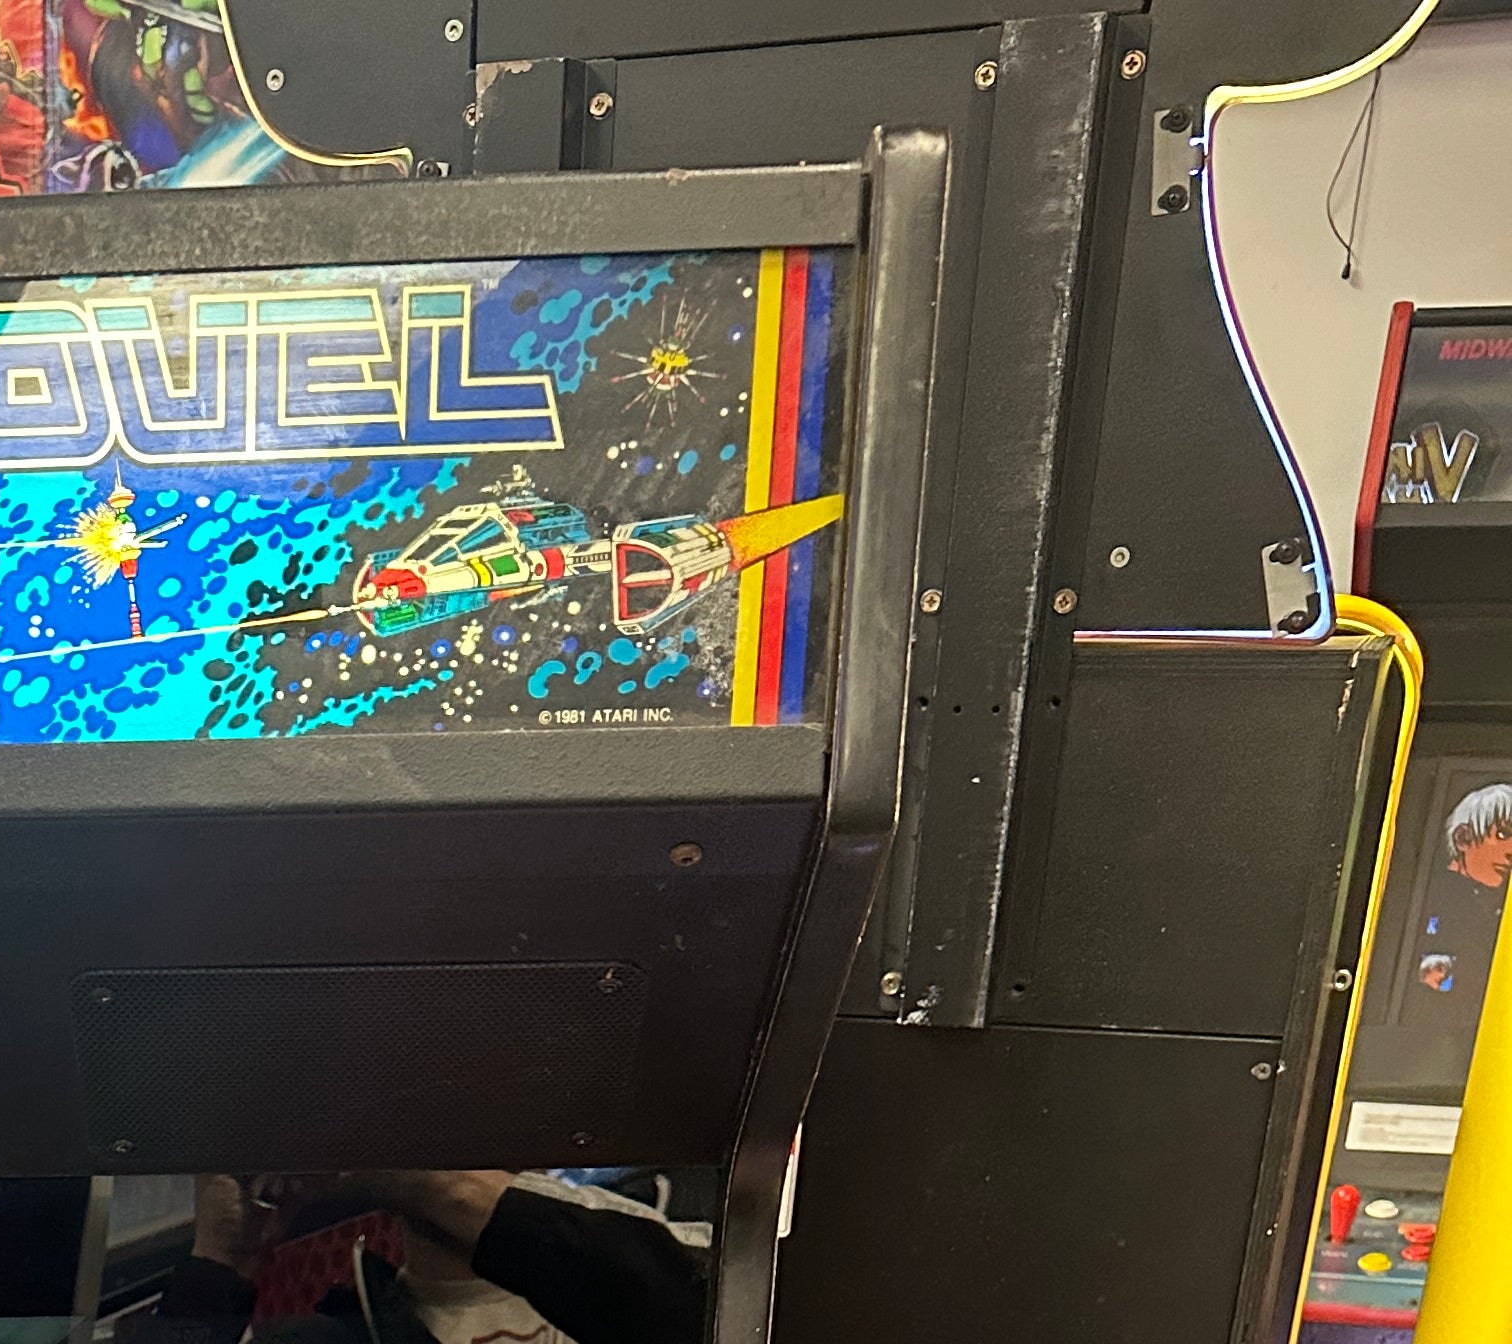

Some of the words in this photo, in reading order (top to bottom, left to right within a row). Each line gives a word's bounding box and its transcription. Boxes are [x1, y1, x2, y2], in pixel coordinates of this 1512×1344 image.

[1440, 338, 1512, 361] MIDW
[592, 707, 638, 723] ATARI
[643, 707, 674, 722] INC.
